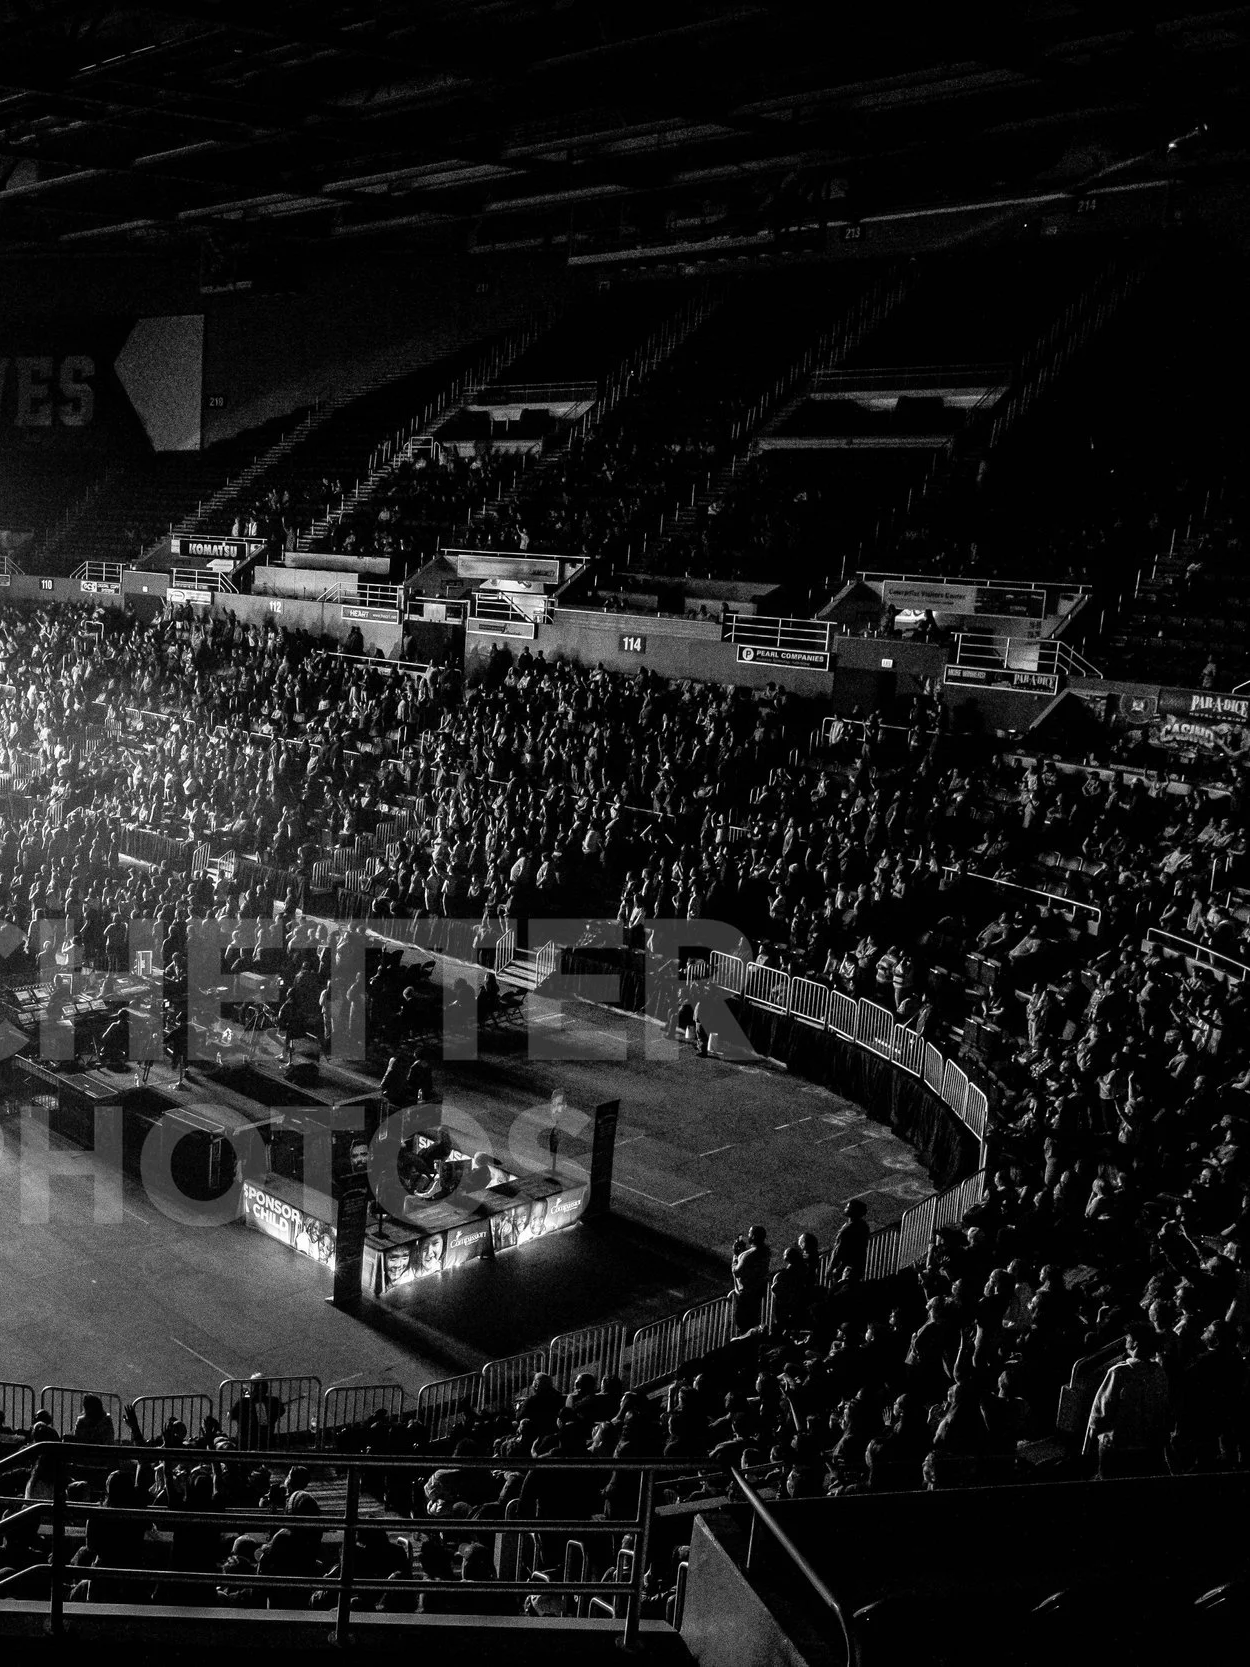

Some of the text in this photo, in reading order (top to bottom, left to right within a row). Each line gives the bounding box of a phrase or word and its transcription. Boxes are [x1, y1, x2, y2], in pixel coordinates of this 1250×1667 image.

[188, 543, 238, 558] KOMATSU
[41, 579, 53, 590] 110
[269, 601, 282, 613] 112
[349, 609, 370, 618] HEART
[623, 636, 641, 651] 114
[756, 649, 779, 659] PEARL
[781, 652, 825, 663] COMPANIES
[1160, 723, 1215, 748] CASINO
[243, 1183, 301, 1222] SPONSOR
[252, 1203, 288, 1232] CHILD
